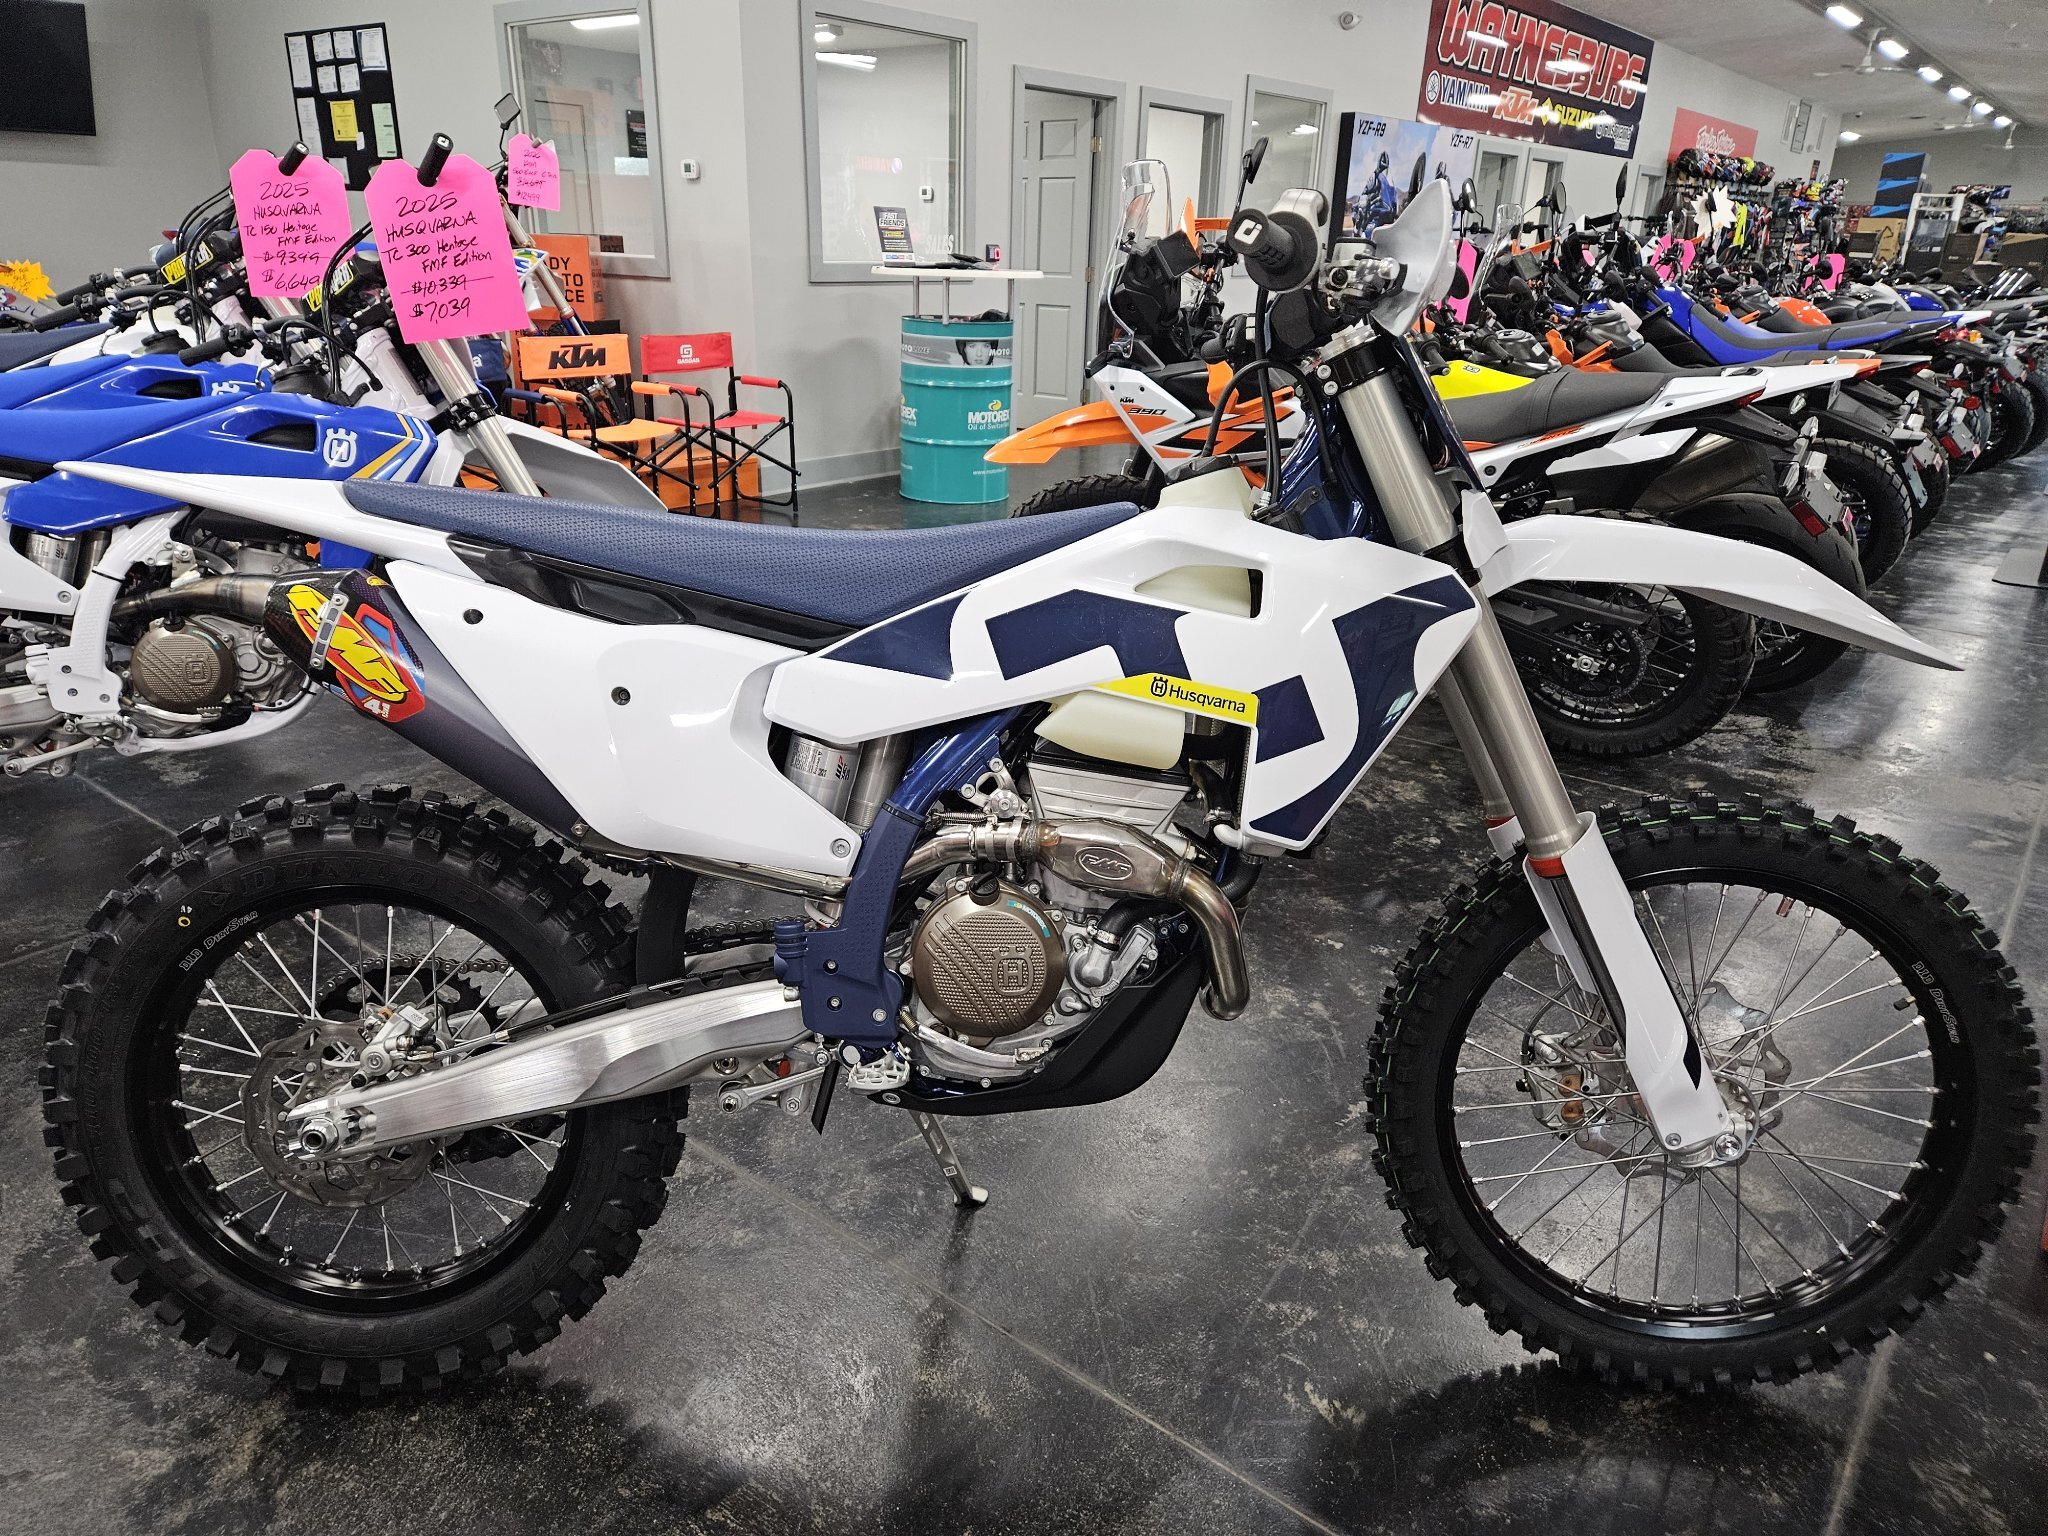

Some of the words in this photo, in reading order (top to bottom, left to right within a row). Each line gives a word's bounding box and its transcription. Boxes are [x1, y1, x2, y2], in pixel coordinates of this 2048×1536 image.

[1438, 0, 1646, 110] WAYNESBURG
[1440, 74, 1490, 113] YAMAHA
[1493, 87, 1540, 125] KTM
[1357, 119, 1387, 137] YZF-R9
[1450, 134, 1474, 149] YZF-R7
[260, 182, 309, 200] 2025
[253, 202, 322, 220] HUSQVARNA
[396, 192, 458, 218] 2025
[244, 225, 257, 236] TC
[283, 221, 318, 236] Heritage
[385, 211, 479, 242] HUSQVARNA
[880, 219, 905, 227] FRIENDS
[278, 236, 301, 247] FMF
[305, 234, 337, 244] Edition
[381, 250, 404, 264] TC
[406, 244, 431, 258] 300
[436, 235, 479, 256] Heritage
[422, 257, 448, 274] FMF
[454, 252, 493, 268] Edition
[548, 343, 606, 370] KTM
[1168, 684, 1246, 714] Husqvarna
[1080, 852, 1133, 874] FMF
